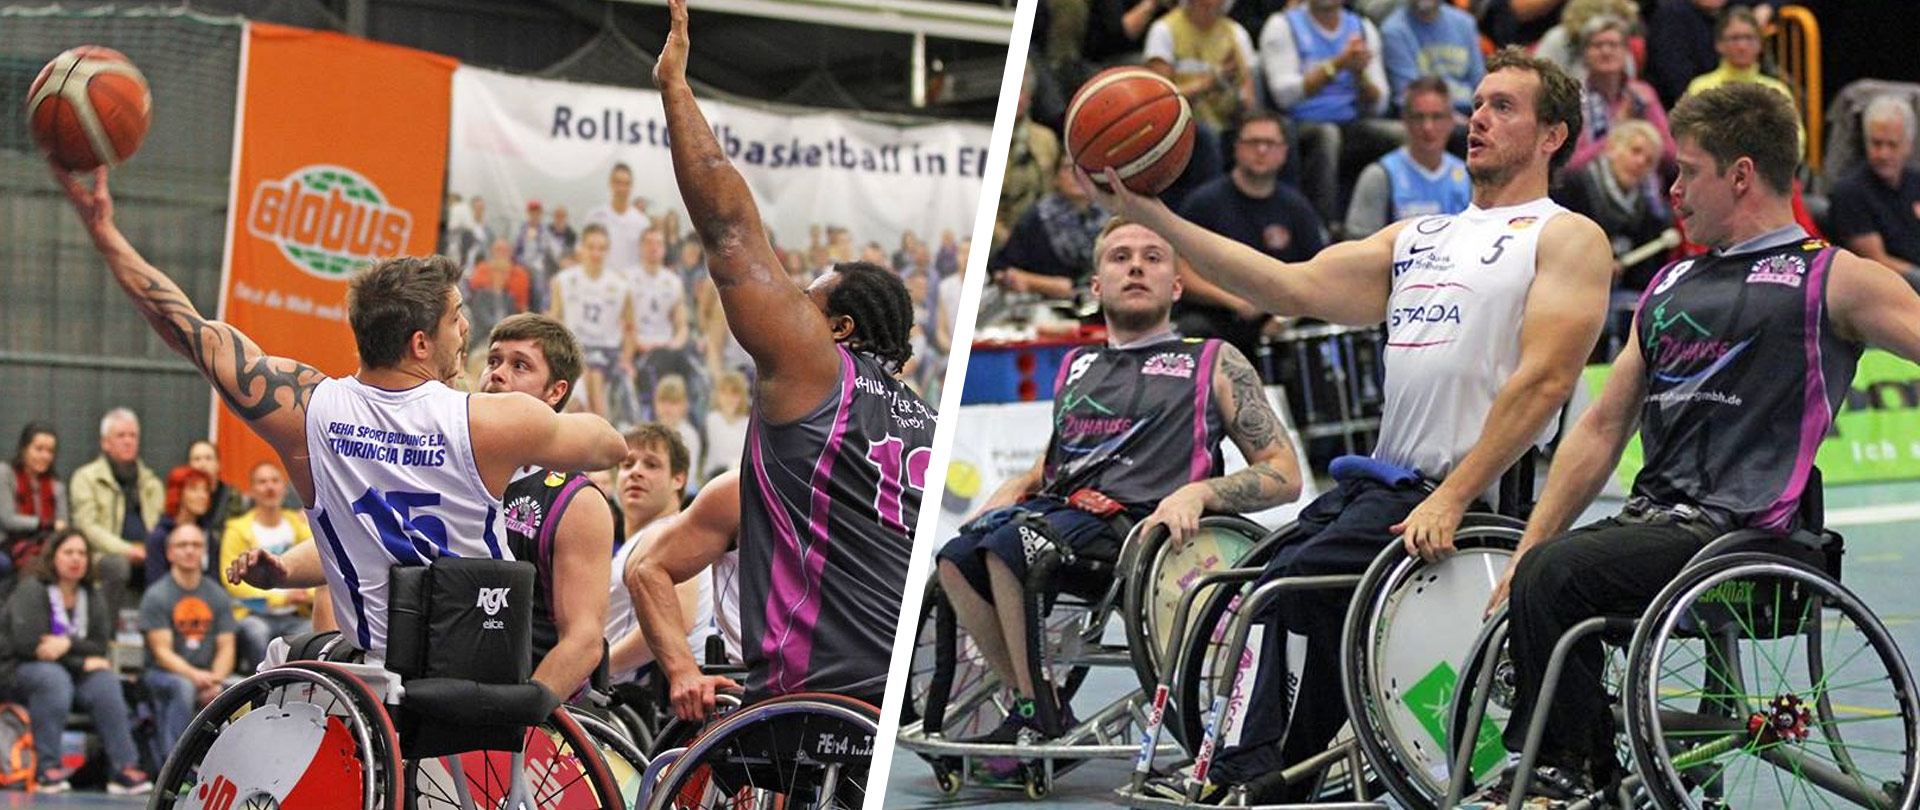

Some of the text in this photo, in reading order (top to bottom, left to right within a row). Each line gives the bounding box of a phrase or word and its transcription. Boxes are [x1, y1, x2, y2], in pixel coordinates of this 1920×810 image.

[912, 143, 947, 175] in
[1481, 235, 1514, 265] 5
[1392, 304, 1461, 327] STADA
[328, 421, 446, 447] REHA SPORT BILDUNG E.V.
[329, 438, 446, 467] THURINGIA BULLS
[351, 486, 461, 567] 15
[1018, 526, 1036, 565] adida
[476, 587, 511, 616] RGK
[482, 618, 505, 630] elite
